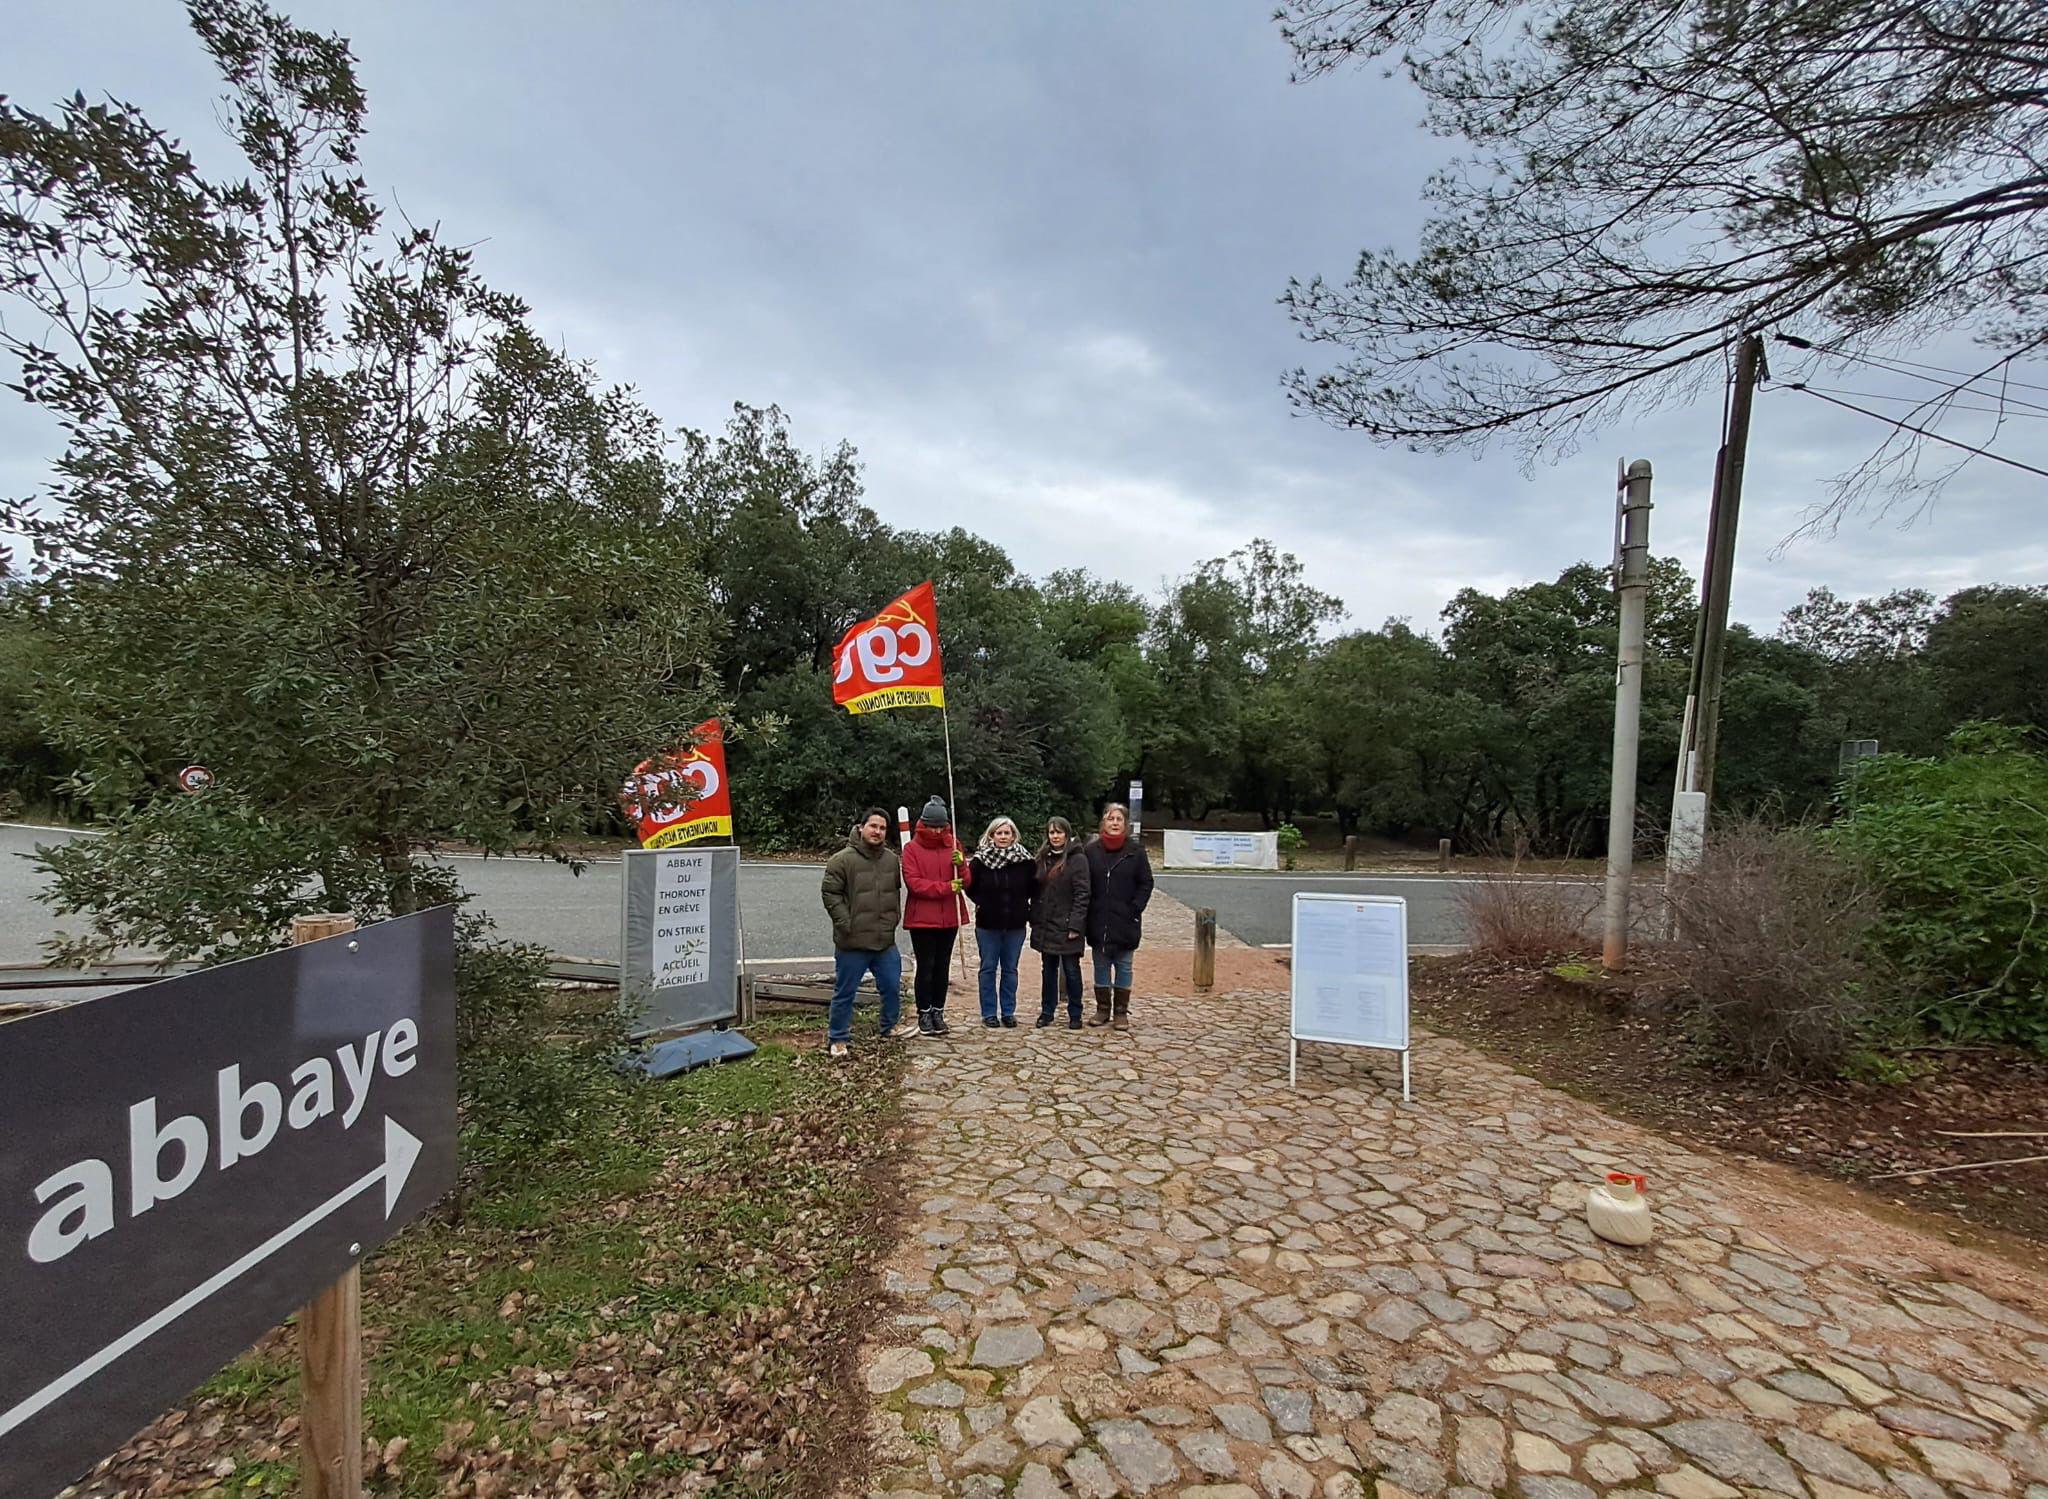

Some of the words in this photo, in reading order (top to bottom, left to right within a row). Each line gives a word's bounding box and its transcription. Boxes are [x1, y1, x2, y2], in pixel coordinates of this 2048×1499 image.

[667, 858, 703, 868] ABBAYE
[677, 874, 691, 883] DU
[660, 888, 706, 900] THORONET
[658, 906, 670, 915] EN
[673, 903, 700, 914] GRÈVE
[658, 928, 672, 938] ON
[675, 925, 705, 936] STRIKE
[662, 958, 700, 971] ACCUEIL
[660, 974, 697, 987] SACRIFIÉ
[27, 1018, 418, 1263] abbaye
